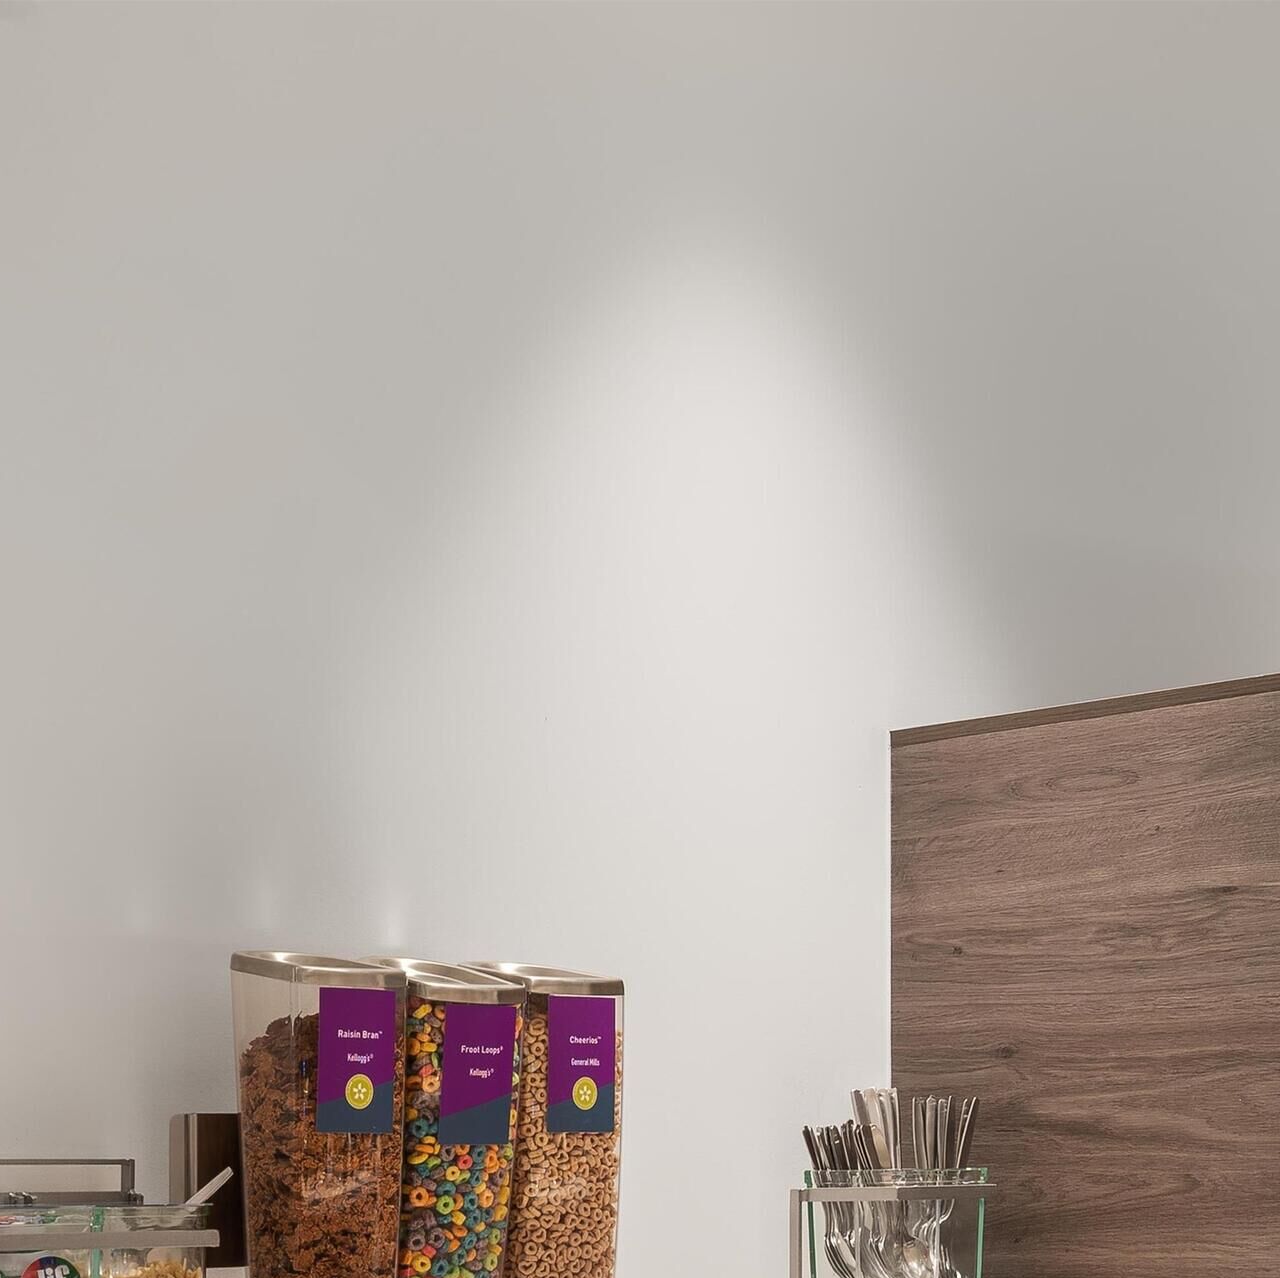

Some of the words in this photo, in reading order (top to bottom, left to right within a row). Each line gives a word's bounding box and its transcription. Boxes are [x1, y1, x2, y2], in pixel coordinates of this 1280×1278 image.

[337, 1029, 361, 1039] Raisin
[460, 1044, 480, 1054] Froot
[570, 1057, 589, 1066] General
[589, 1058, 600, 1066] Mills
